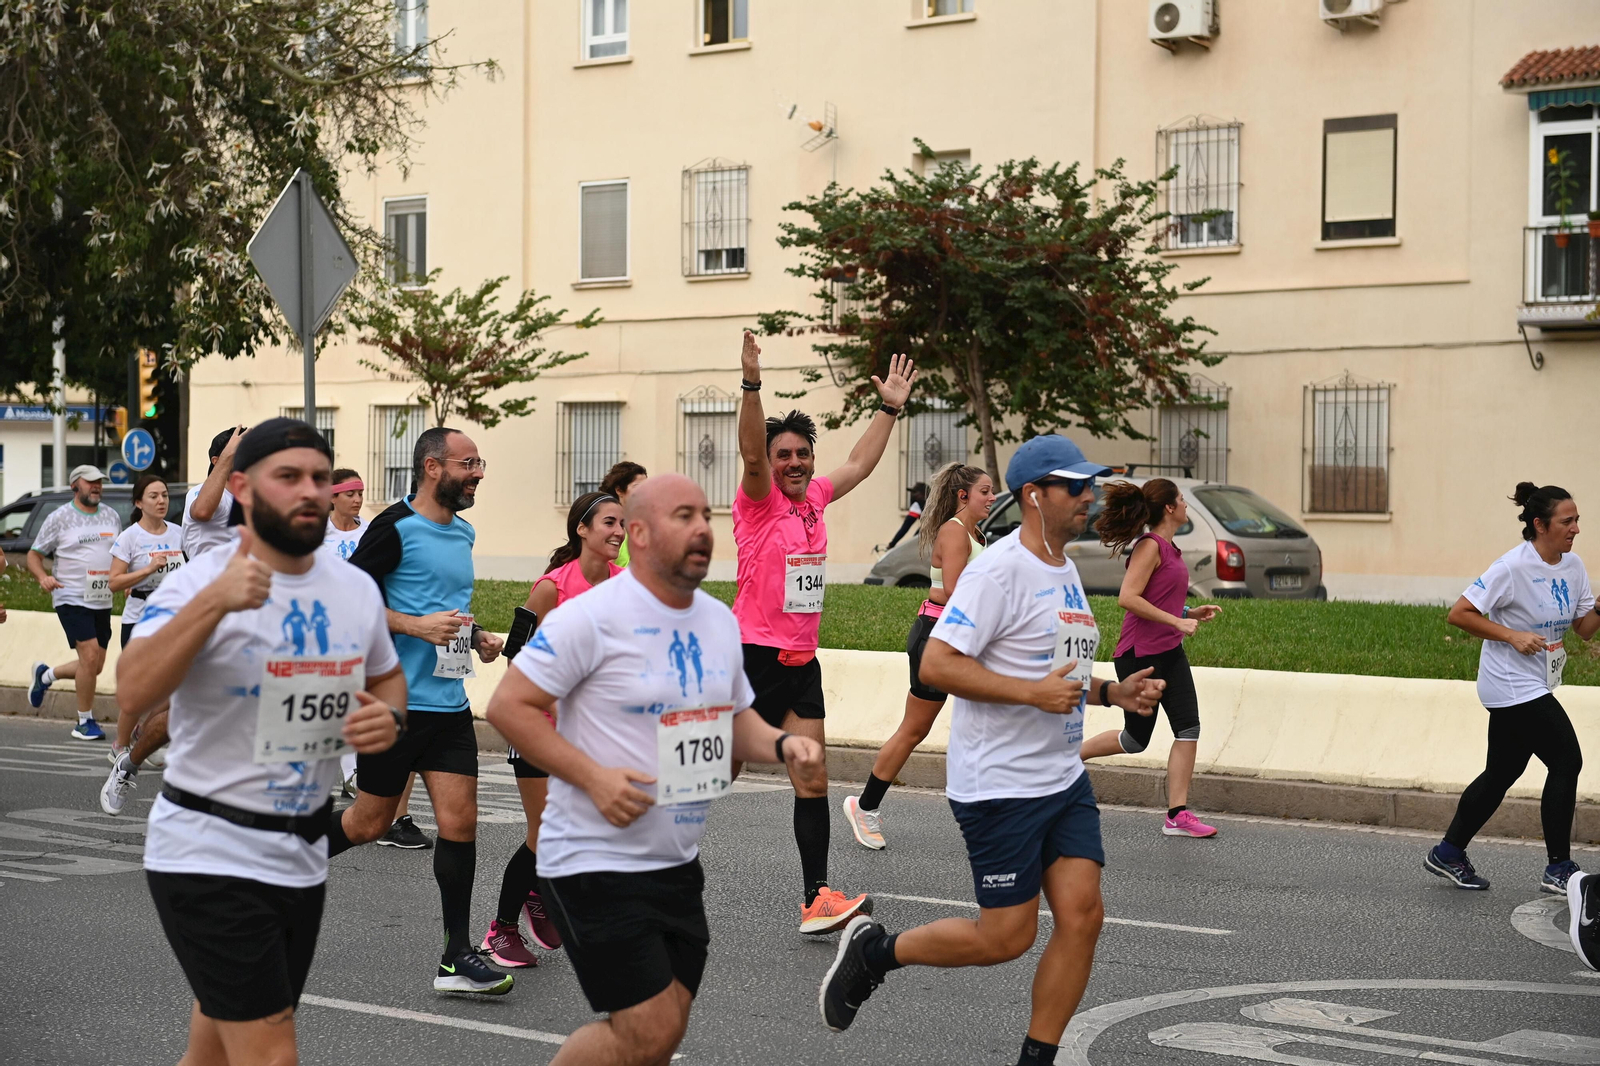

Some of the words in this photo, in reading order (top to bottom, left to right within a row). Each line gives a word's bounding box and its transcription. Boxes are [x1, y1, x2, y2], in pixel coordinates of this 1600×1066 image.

[787, 557, 801, 567] 42
[796, 575, 823, 591] 1344
[1058, 612, 1073, 624] 42
[267, 661, 293, 677] 42
[282, 691, 350, 722] 1569
[675, 735, 724, 766] 1780
[983, 873, 1017, 884] RFEA
